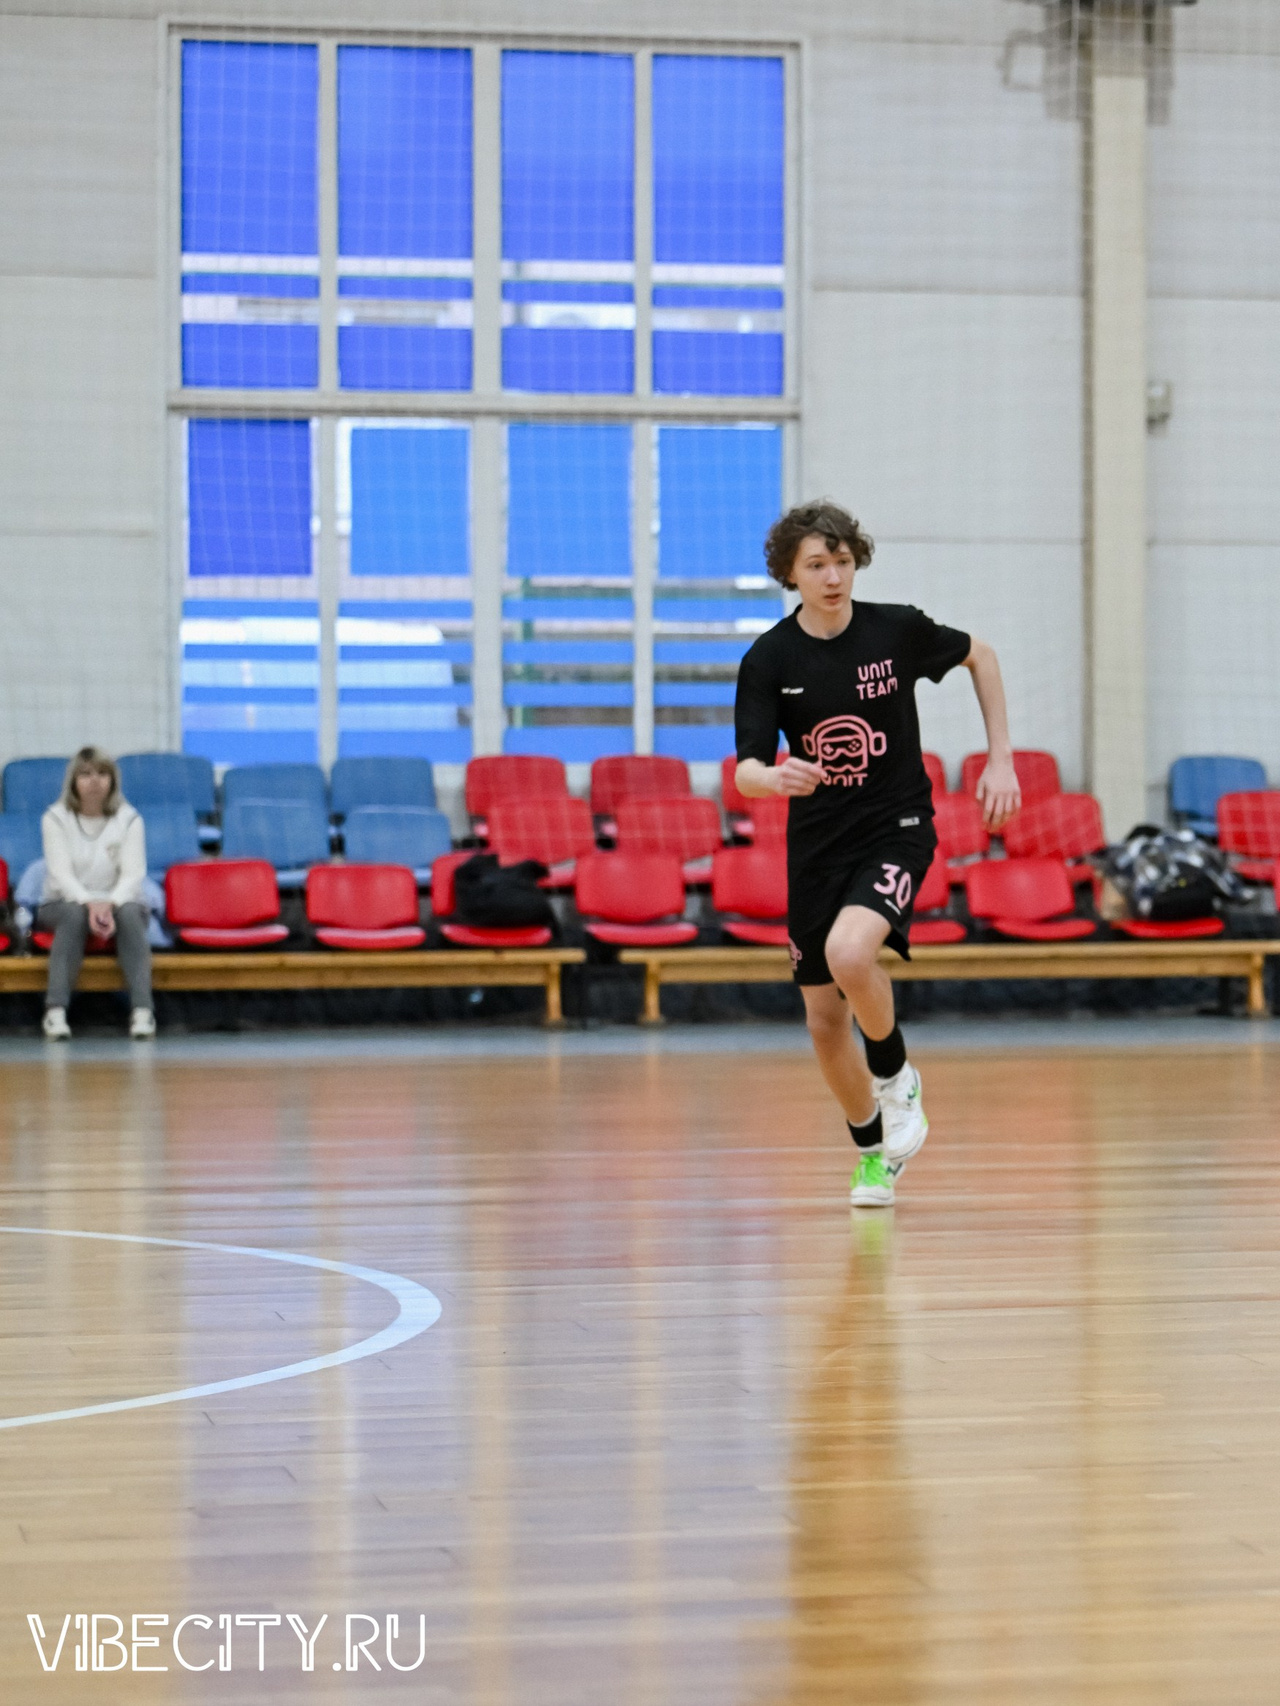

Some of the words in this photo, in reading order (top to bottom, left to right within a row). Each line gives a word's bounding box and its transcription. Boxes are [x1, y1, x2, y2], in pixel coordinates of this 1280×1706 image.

[857, 659, 894, 682] UNIT
[856, 677, 898, 701] TEAM
[873, 863, 912, 909] 30
